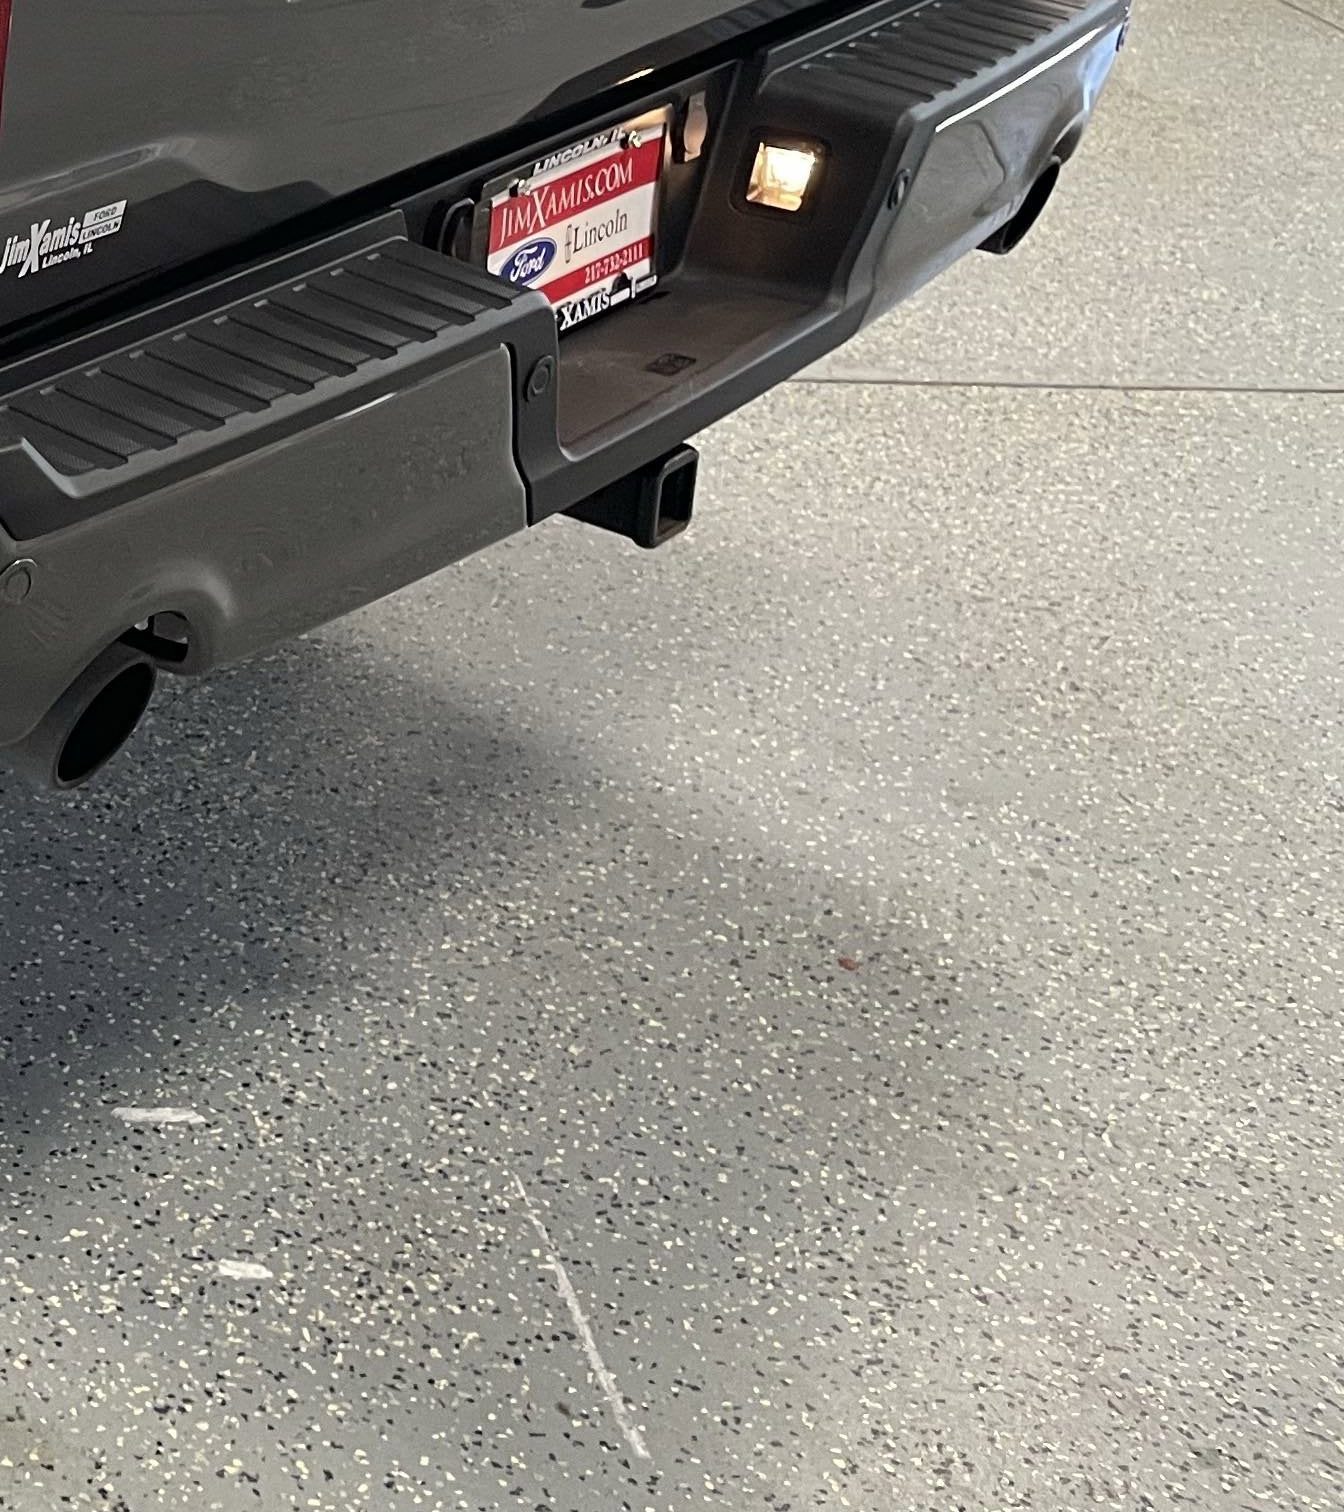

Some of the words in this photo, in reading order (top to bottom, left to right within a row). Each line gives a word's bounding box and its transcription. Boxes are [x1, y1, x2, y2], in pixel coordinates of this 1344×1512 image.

[572, 209, 628, 254] Lincoln
[510, 245, 547, 282] Ford
[559, 291, 610, 331] XAMIS
